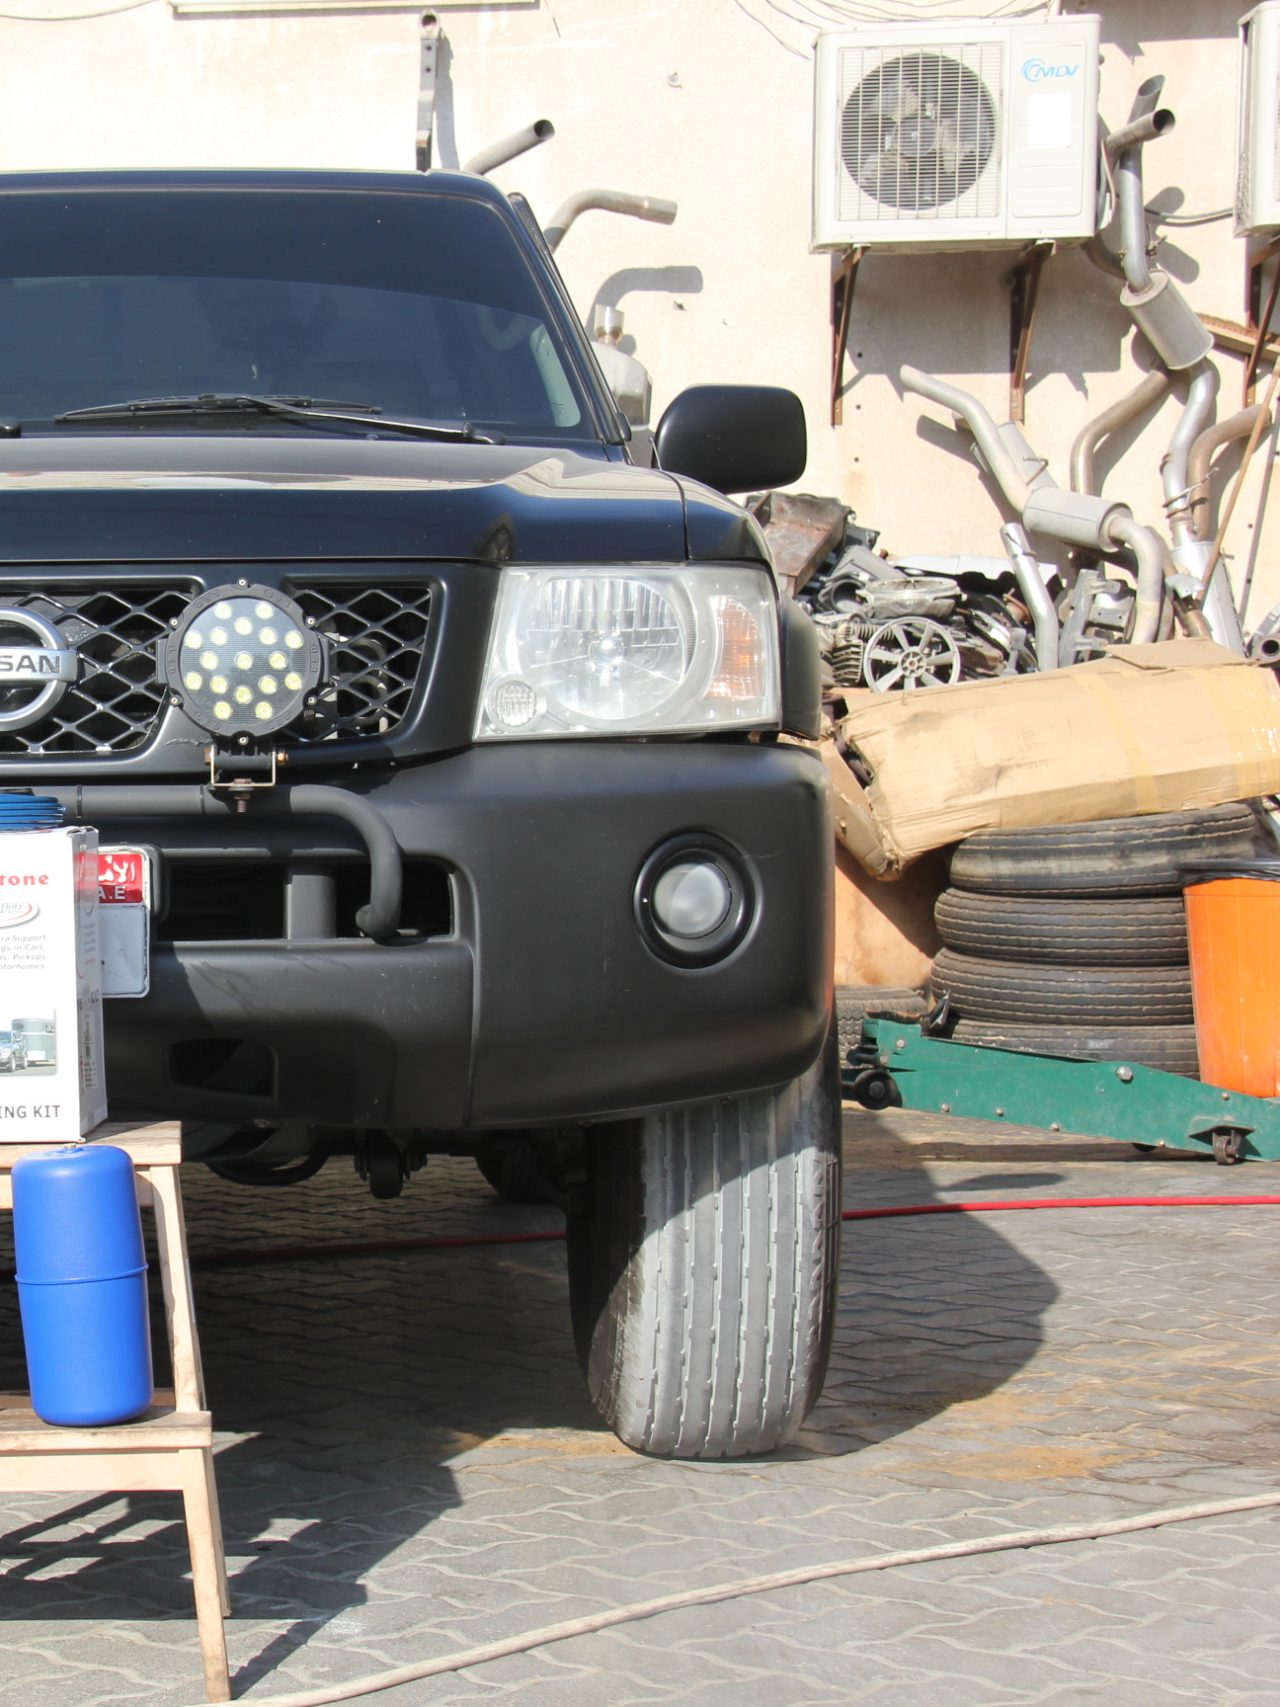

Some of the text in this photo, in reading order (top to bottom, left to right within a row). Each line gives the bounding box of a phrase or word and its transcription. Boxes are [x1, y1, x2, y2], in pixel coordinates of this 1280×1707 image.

[97, 885, 127, 900] A.E
[12, 933, 47, 943] Support
[33, 1104, 62, 1118] KIT
